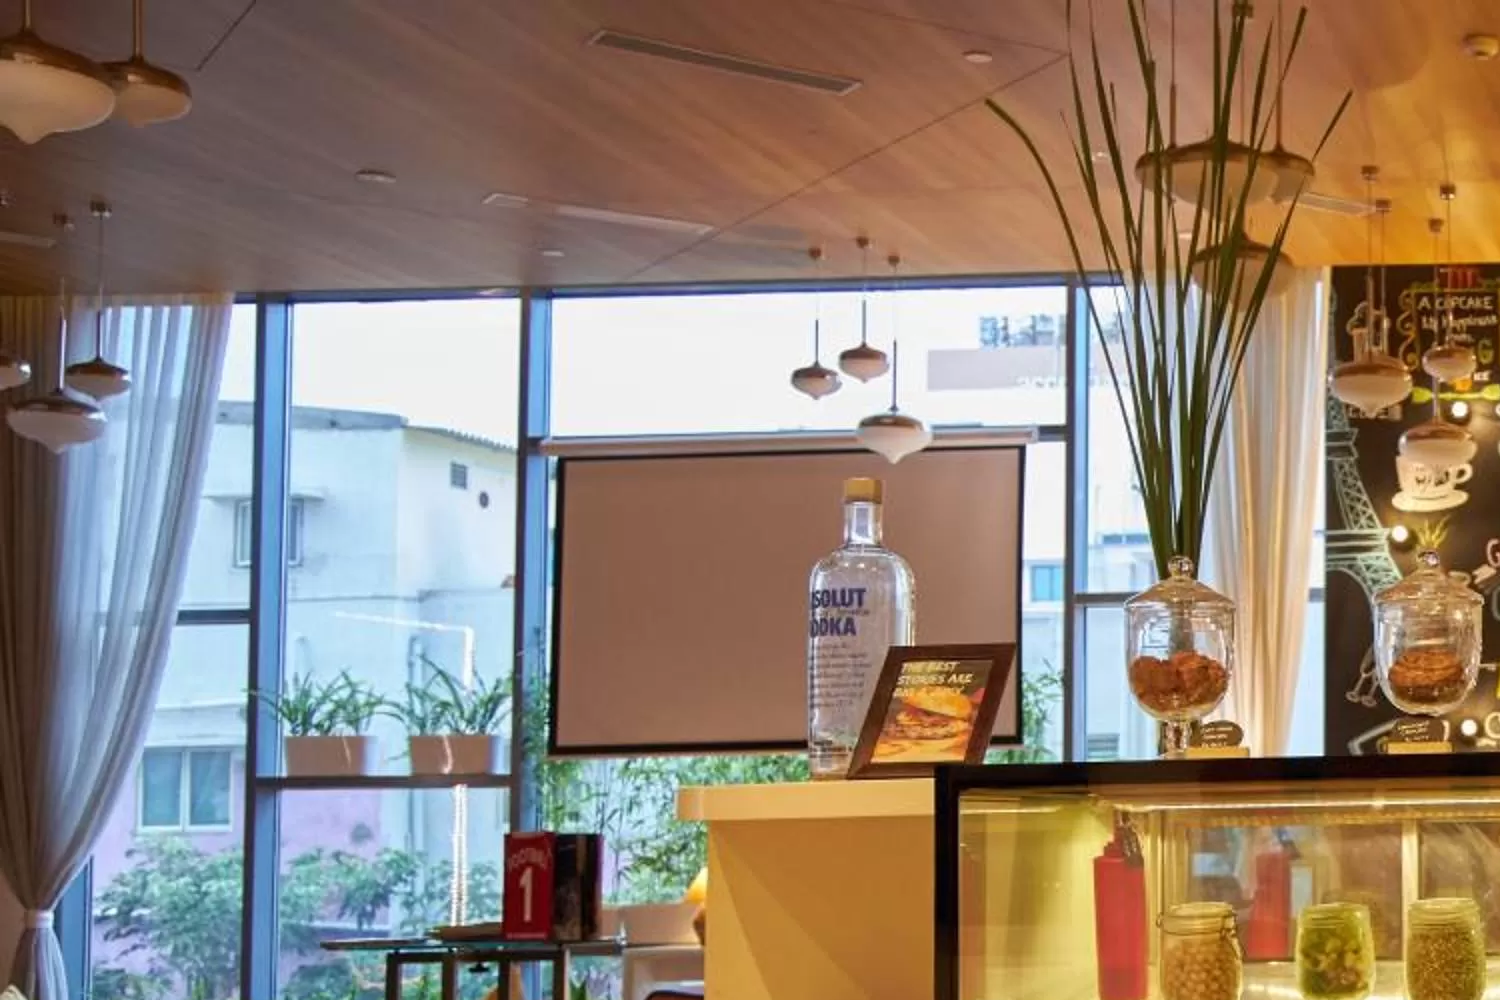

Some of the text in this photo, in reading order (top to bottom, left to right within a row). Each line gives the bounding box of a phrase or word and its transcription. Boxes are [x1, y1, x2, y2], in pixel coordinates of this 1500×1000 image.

[1435, 294, 1495, 310] CPCAKE
[811, 587, 867, 609] SOLUT
[809, 617, 858, 638] ODKA
[519, 866, 533, 923] 1
